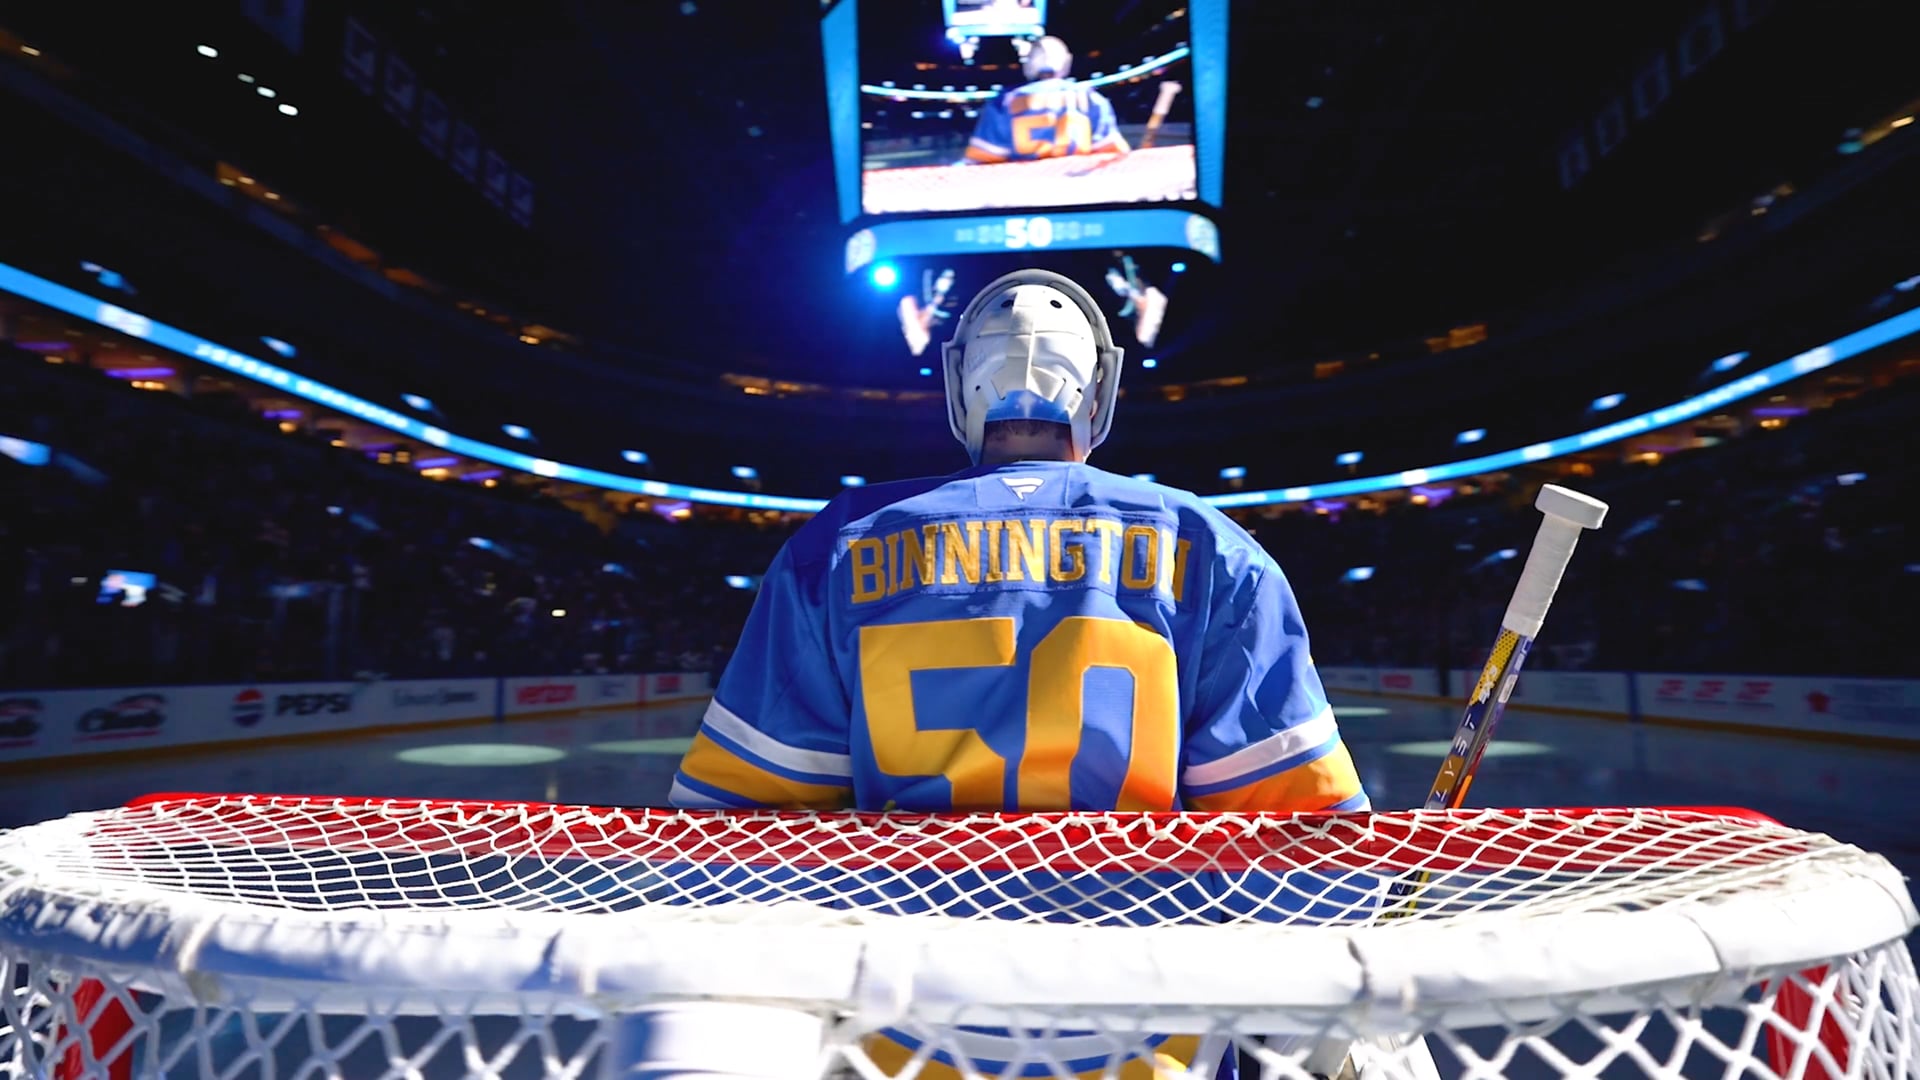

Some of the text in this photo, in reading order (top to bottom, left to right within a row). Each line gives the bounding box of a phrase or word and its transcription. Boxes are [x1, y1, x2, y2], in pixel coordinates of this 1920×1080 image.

[1004, 216, 1053, 249] 50
[848, 518, 1192, 604] BINNINGTON
[276, 692, 352, 717] PEPSI
[858, 615, 1181, 811] 50
